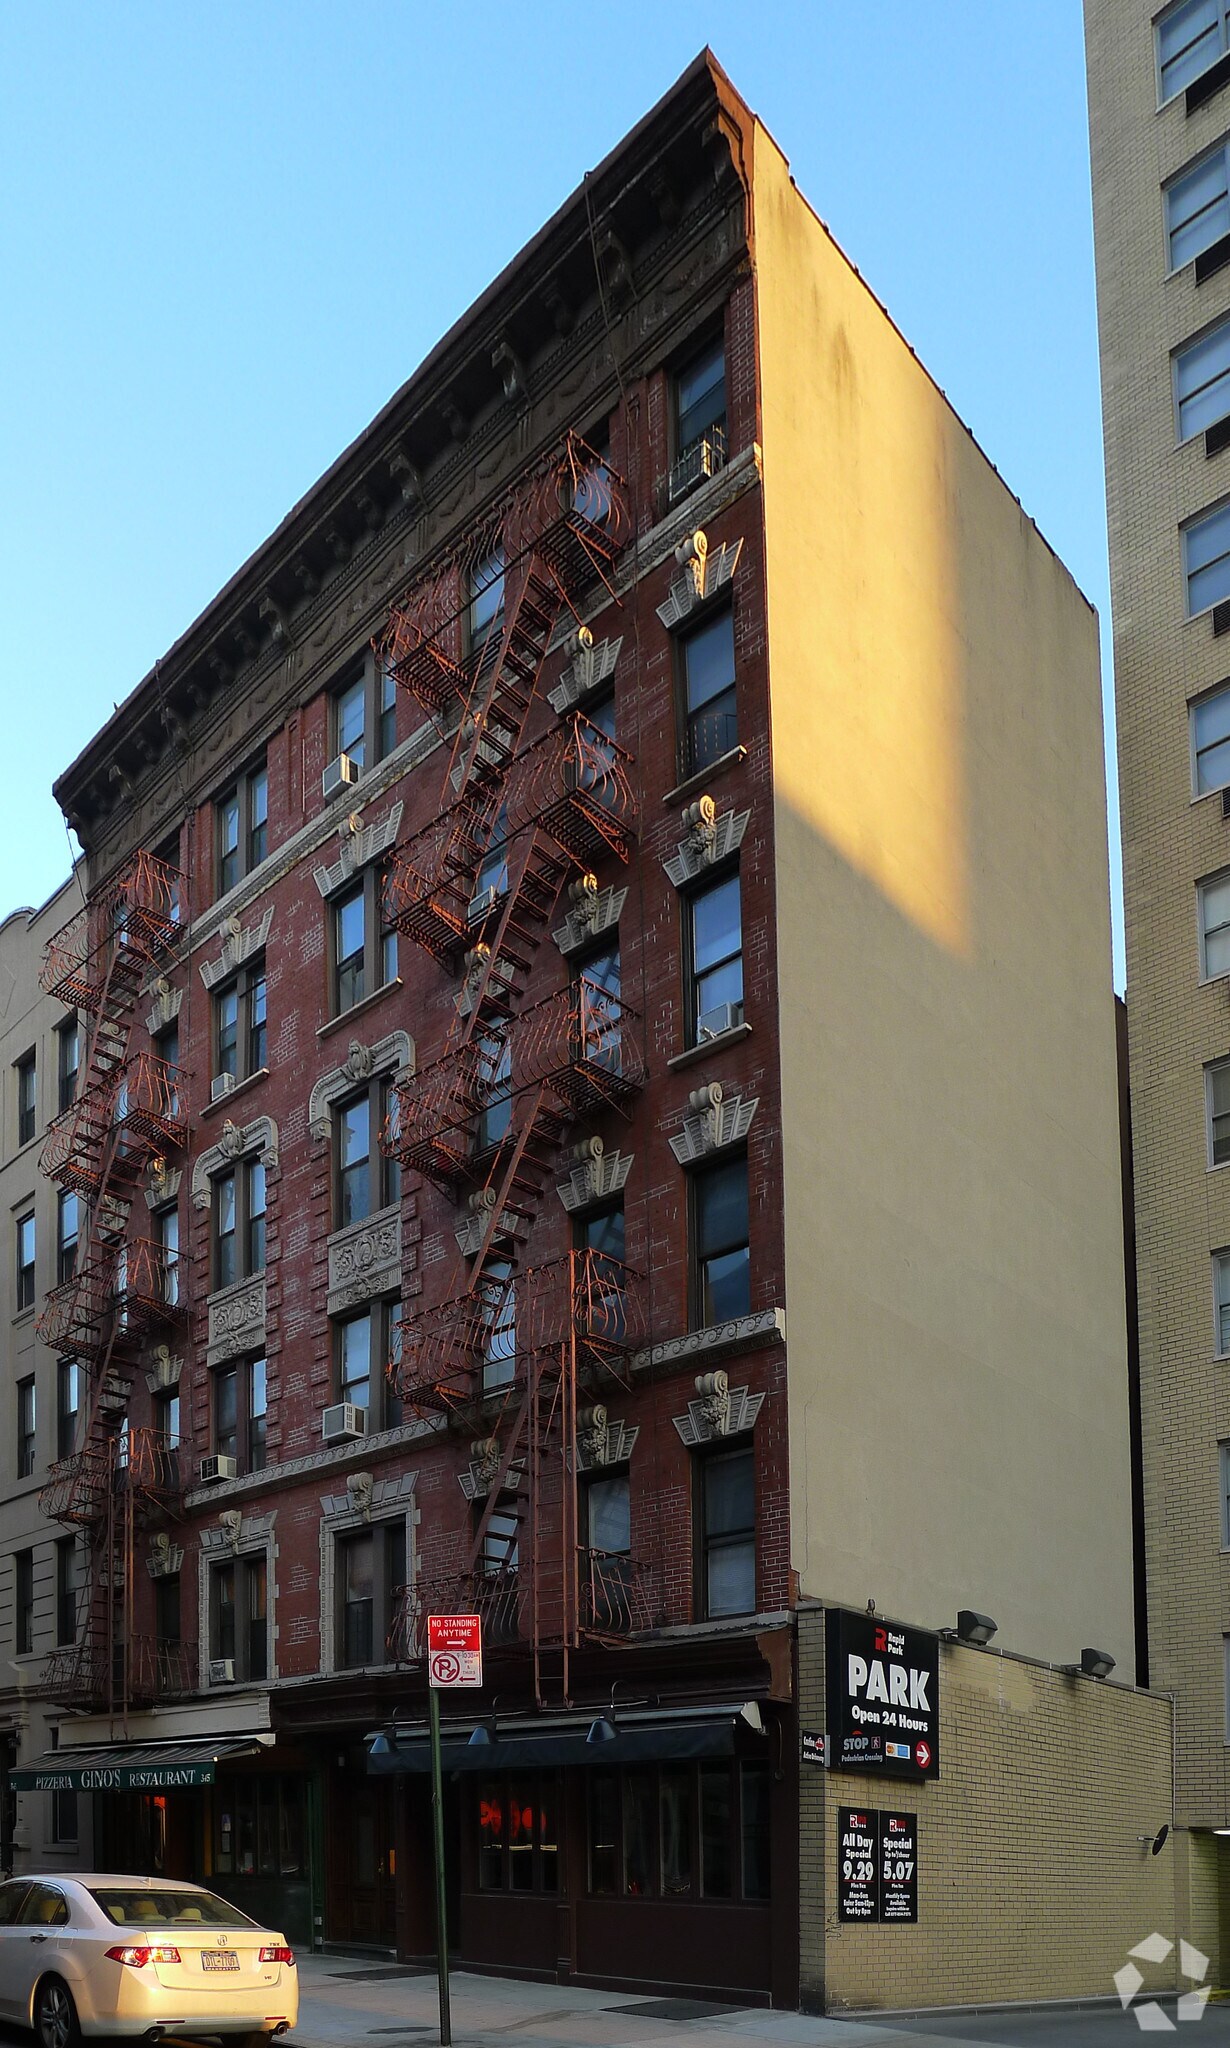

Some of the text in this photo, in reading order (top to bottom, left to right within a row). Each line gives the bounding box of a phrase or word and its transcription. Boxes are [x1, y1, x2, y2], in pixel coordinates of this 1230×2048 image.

[431, 1620, 442, 1628] NO
[437, 1629, 472, 1637] ANYTIME
[888, 1632, 905, 1646] Rapid
[888, 1643, 904, 1656] Park
[848, 1654, 931, 1712] PARK
[852, 1705, 929, 1732] Open 24 Hours
[843, 1738, 869, 1750] STOP
[841, 1752, 883, 1762] Pedestrian Crossing
[36, 1776, 73, 1790] PIZZERIA
[81, 1769, 121, 1788] GINO'S
[129, 1770, 196, 1786] RESTAURANT
[842, 1833, 874, 1851] All Day
[883, 1837, 912, 1851] Special
[846, 1848, 872, 1860] Special
[843, 1860, 874, 1880] 9.29
[884, 1861, 914, 1880] 5.07
